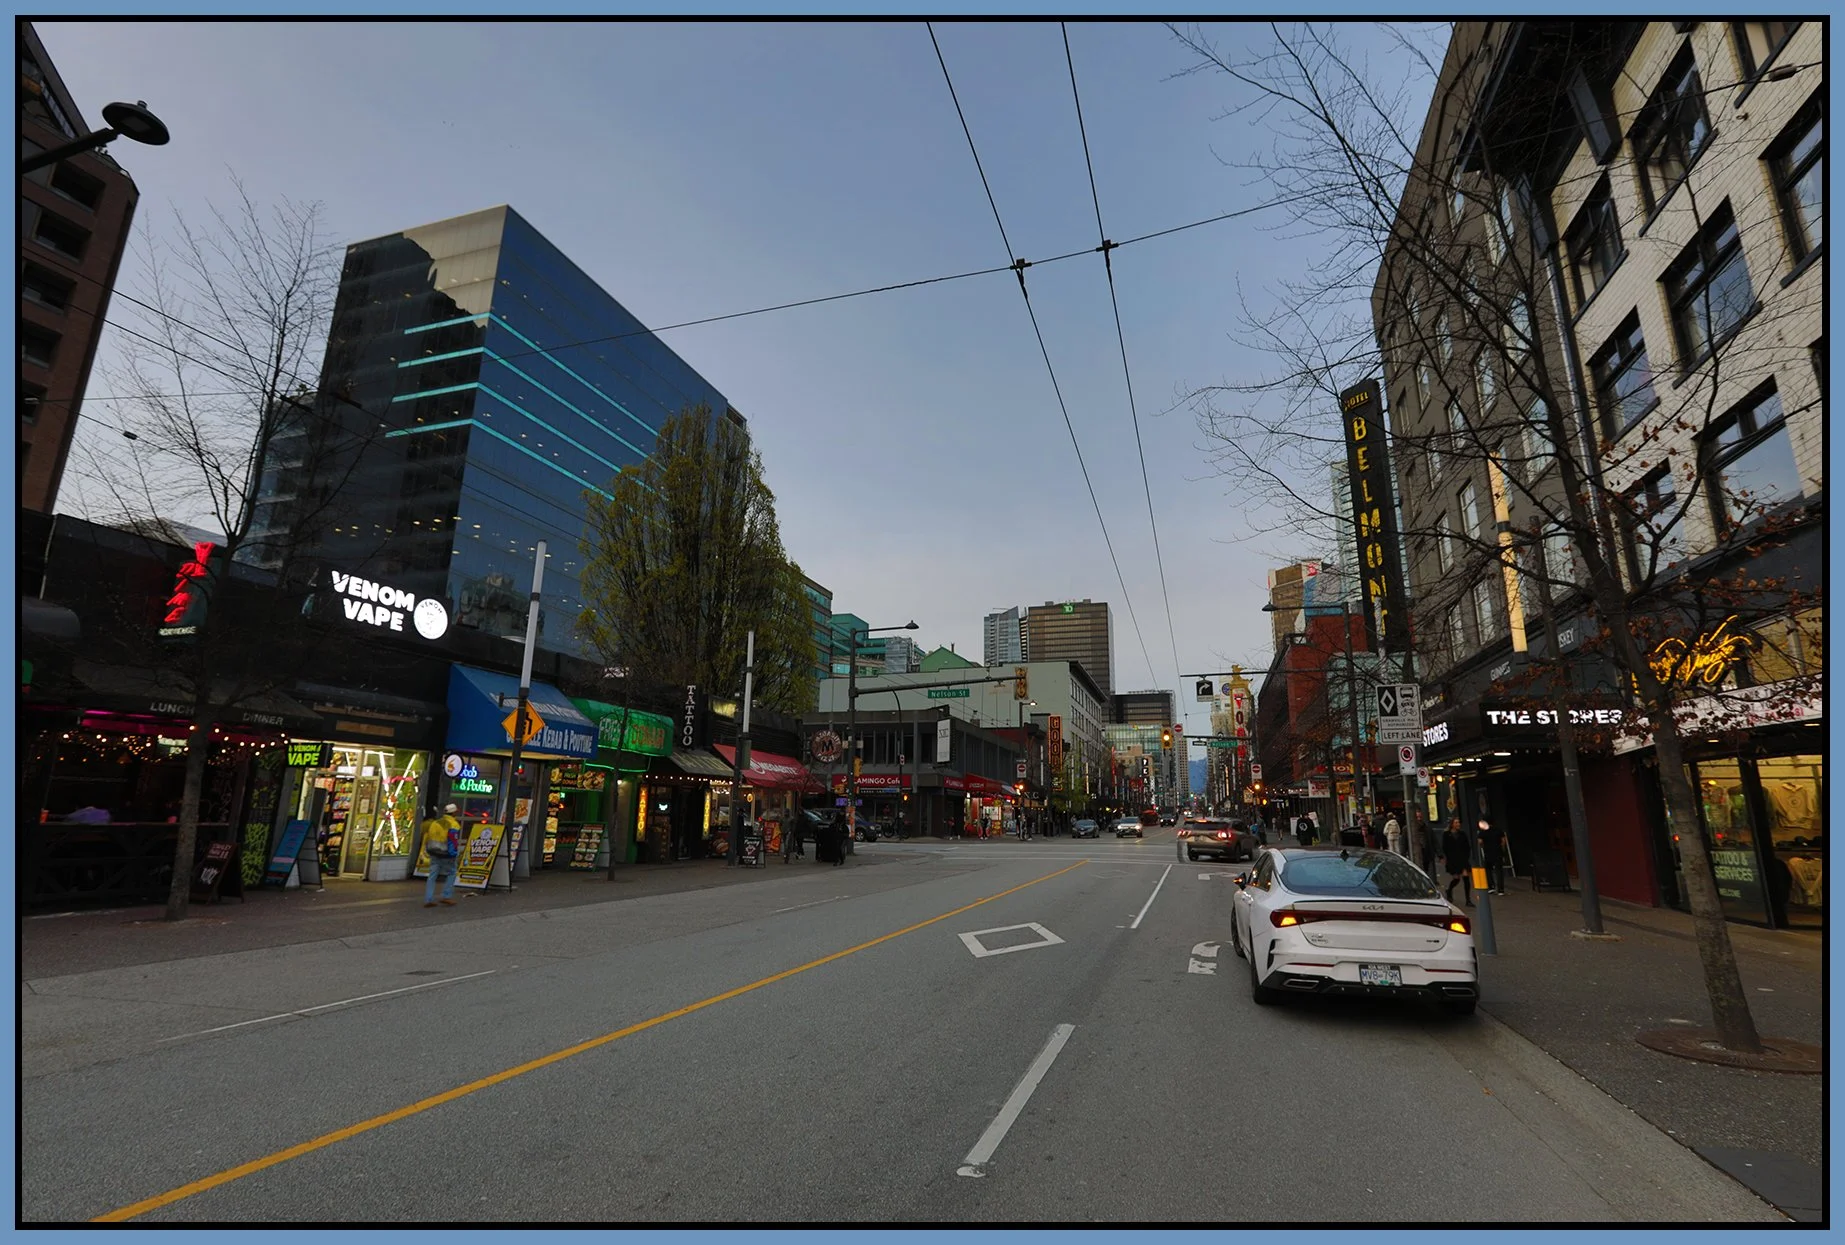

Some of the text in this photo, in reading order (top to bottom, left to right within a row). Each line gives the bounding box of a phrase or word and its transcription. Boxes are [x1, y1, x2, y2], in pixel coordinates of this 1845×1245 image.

[331, 570, 415, 612] VENOM
[343, 598, 404, 632] VAPE
[1063, 605, 1073, 613] TD
[149, 701, 196, 715] LUNCH
[242, 712, 284, 725] DINNER
[682, 685, 696, 746] TATTOO
[1486, 710, 1531, 725] THE
[1401, 731, 1421, 739] LANE
[1422, 722, 1449, 748] STORES
[288, 752, 319, 765] VAPE
[466, 778, 493, 794] Poutine
[469, 839, 498, 847] VENOM
[471, 845, 493, 854] VAPE
